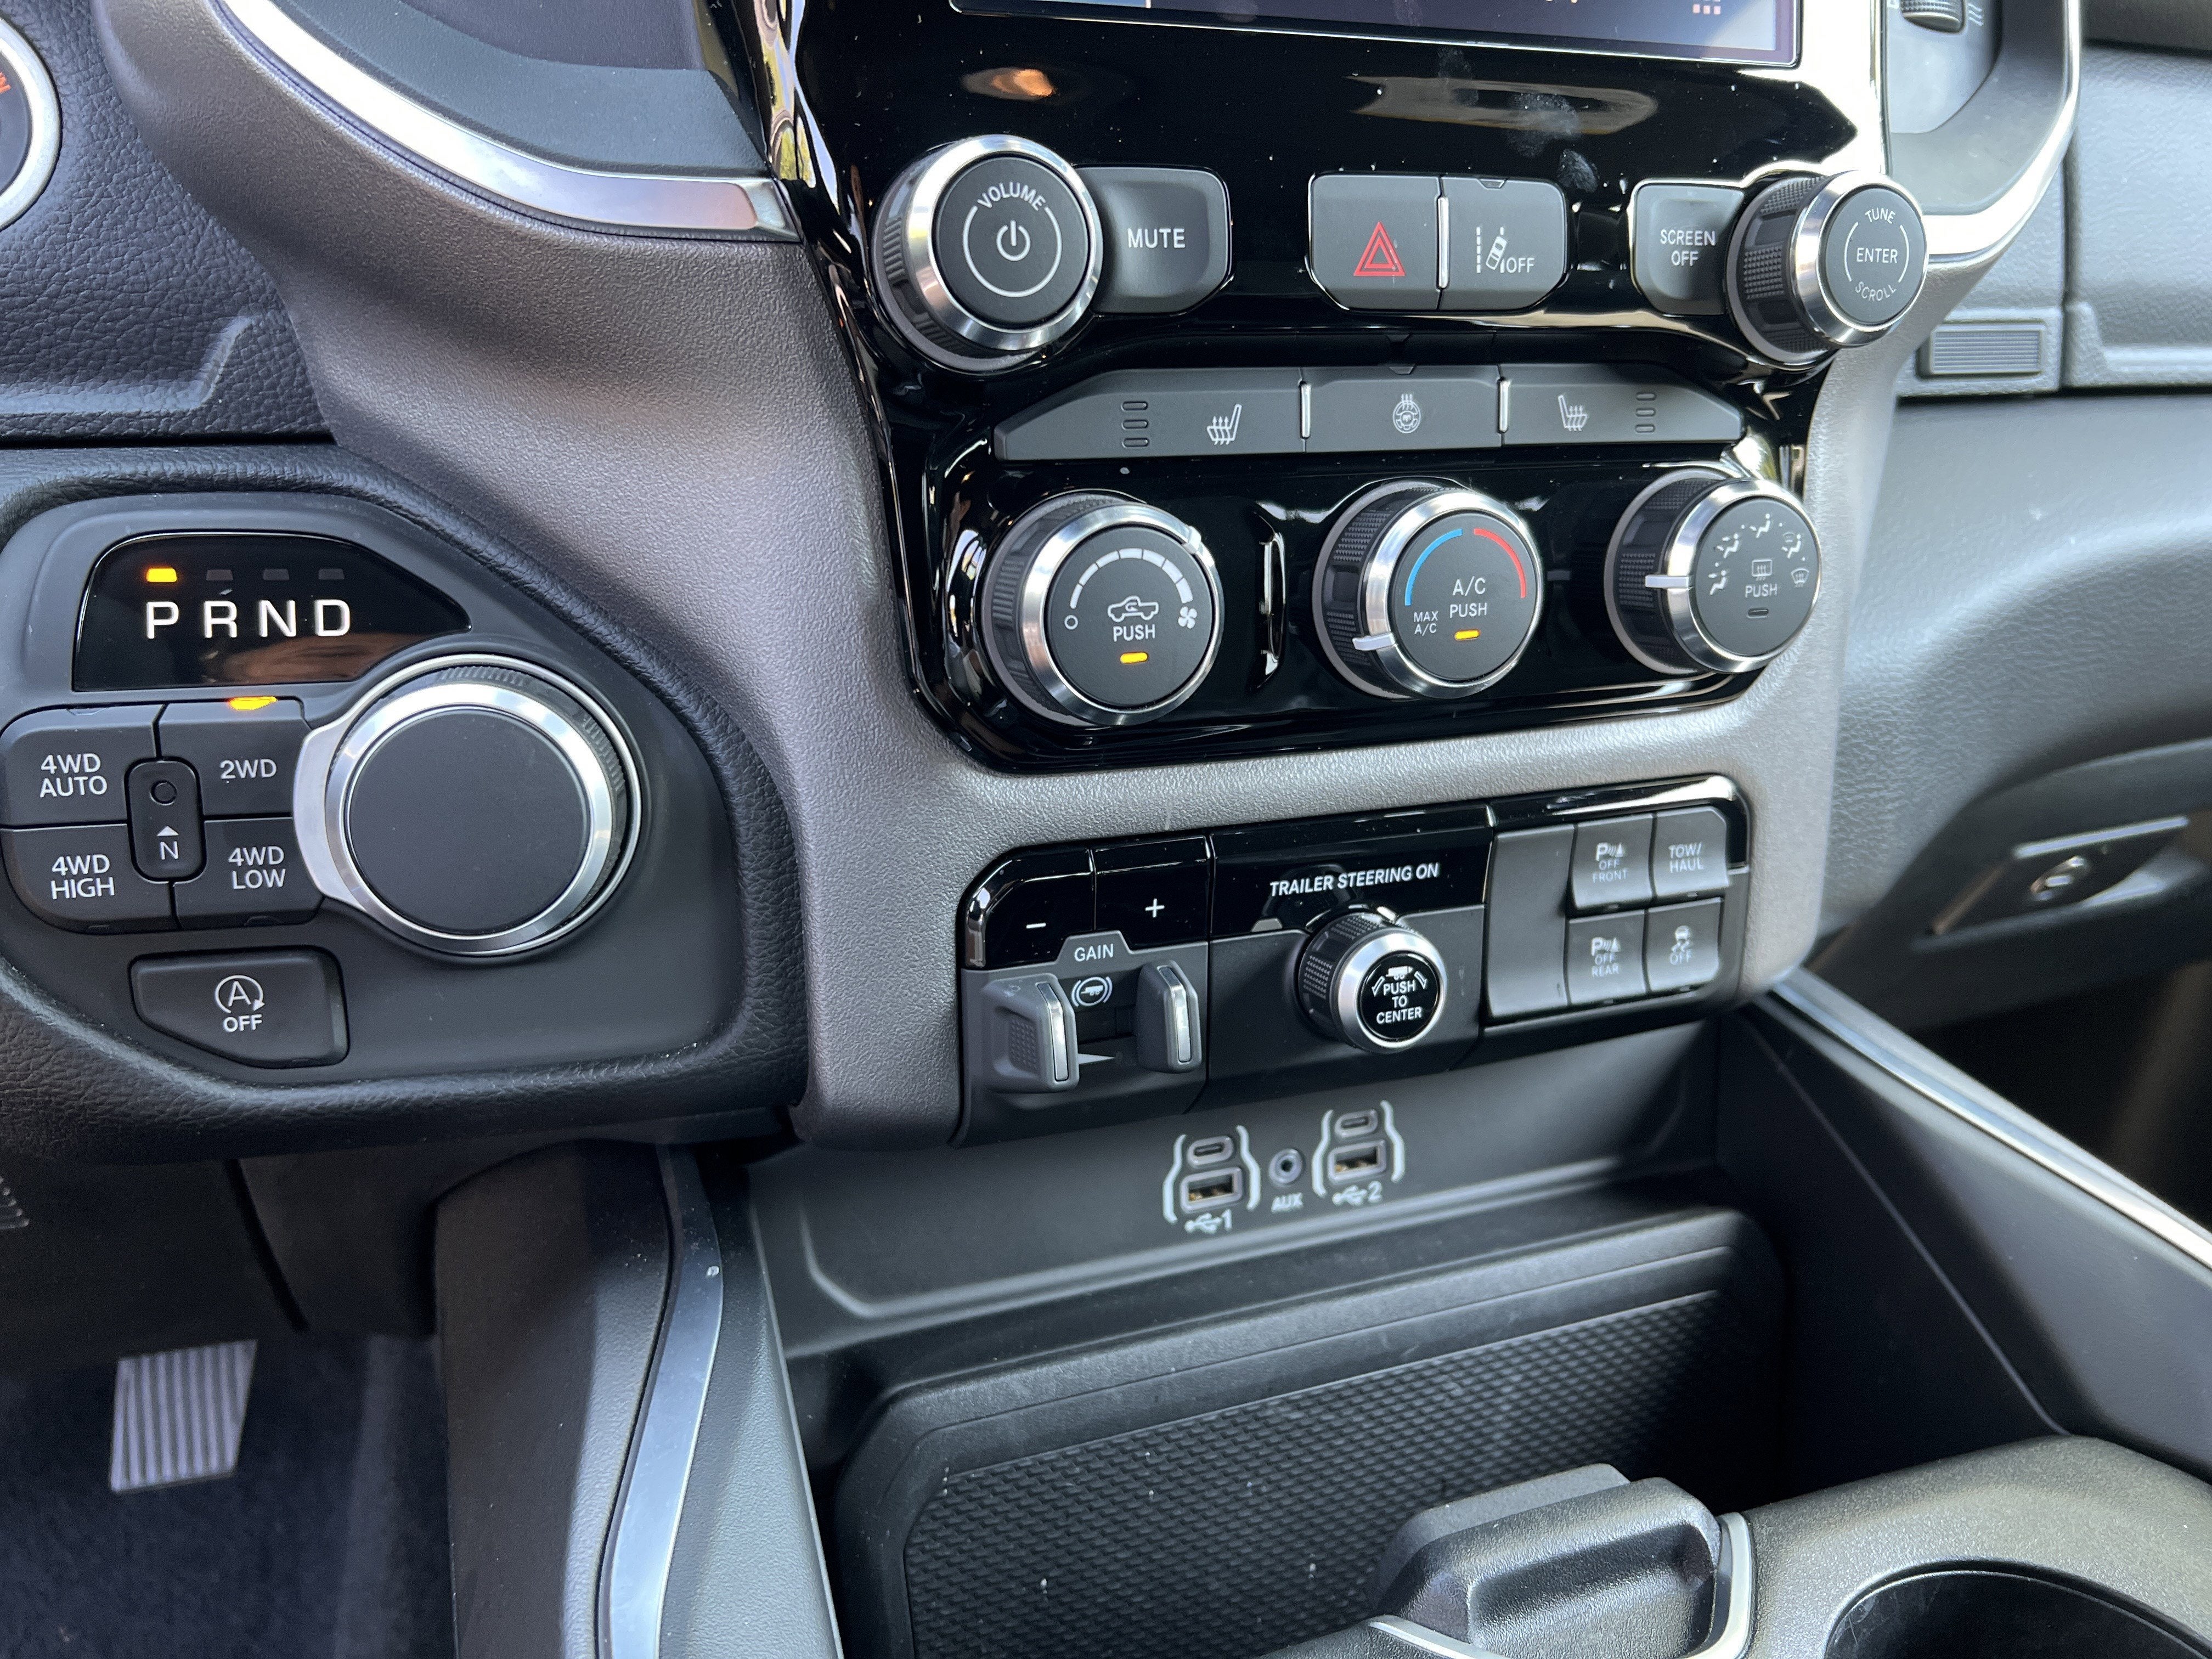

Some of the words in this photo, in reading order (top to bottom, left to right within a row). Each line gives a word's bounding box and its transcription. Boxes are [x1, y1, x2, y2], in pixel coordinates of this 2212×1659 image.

[977, 182, 1046, 211] VOLUME
[1864, 208, 1896, 225] TUNE
[1127, 228, 1186, 249] MUTE
[1660, 229, 1716, 246] SCREEN
[1671, 250, 1699, 268] OFF
[1856, 248, 1898, 264] ENTER
[1506, 257, 1535, 274] OFF
[1853, 281, 1898, 302] SCROLL
[1452, 576, 1487, 596] A/C
[1745, 583, 1778, 598] PUSH
[145, 600, 180, 639] P
[203, 600, 238, 638] R
[258, 599, 297, 637] N
[314, 599, 351, 636] D
[1413, 611, 1439, 623] MAX
[1449, 603, 1488, 618] PUSH
[1113, 623, 1156, 642] PUSH
[1414, 623, 1437, 636] A/C
[41, 753, 101, 775] 4WD
[219, 759, 277, 780] 2WD
[40, 777, 108, 799] AUTO
[159, 841, 179, 861] N
[228, 847, 285, 867] 4WD
[1669, 842, 1702, 859] TOW/
[50, 854, 110, 875] 4WD
[1599, 859, 1620, 870] OFF
[1669, 860, 1704, 873] HAUL
[231, 869, 286, 889] LOW
[1270, 875, 1334, 896] TRAILER
[1338, 866, 1413, 889] STEERING
[1416, 862, 1440, 880] ON
[1593, 868, 1628, 882] FRONT
[50, 878, 115, 900] HIGH
[1074, 943, 1114, 963] GAIN
[1595, 955, 1616, 966] OFF
[1669, 951, 1693, 966] OFF
[1592, 966, 1619, 977] REAR
[1383, 980, 1416, 994] PUSH
[1392, 995, 1408, 1008] TO
[223, 1015, 262, 1032] OFF
[1376, 1007, 1423, 1024] CENTER
[1272, 1192, 1302, 1212] AUX
